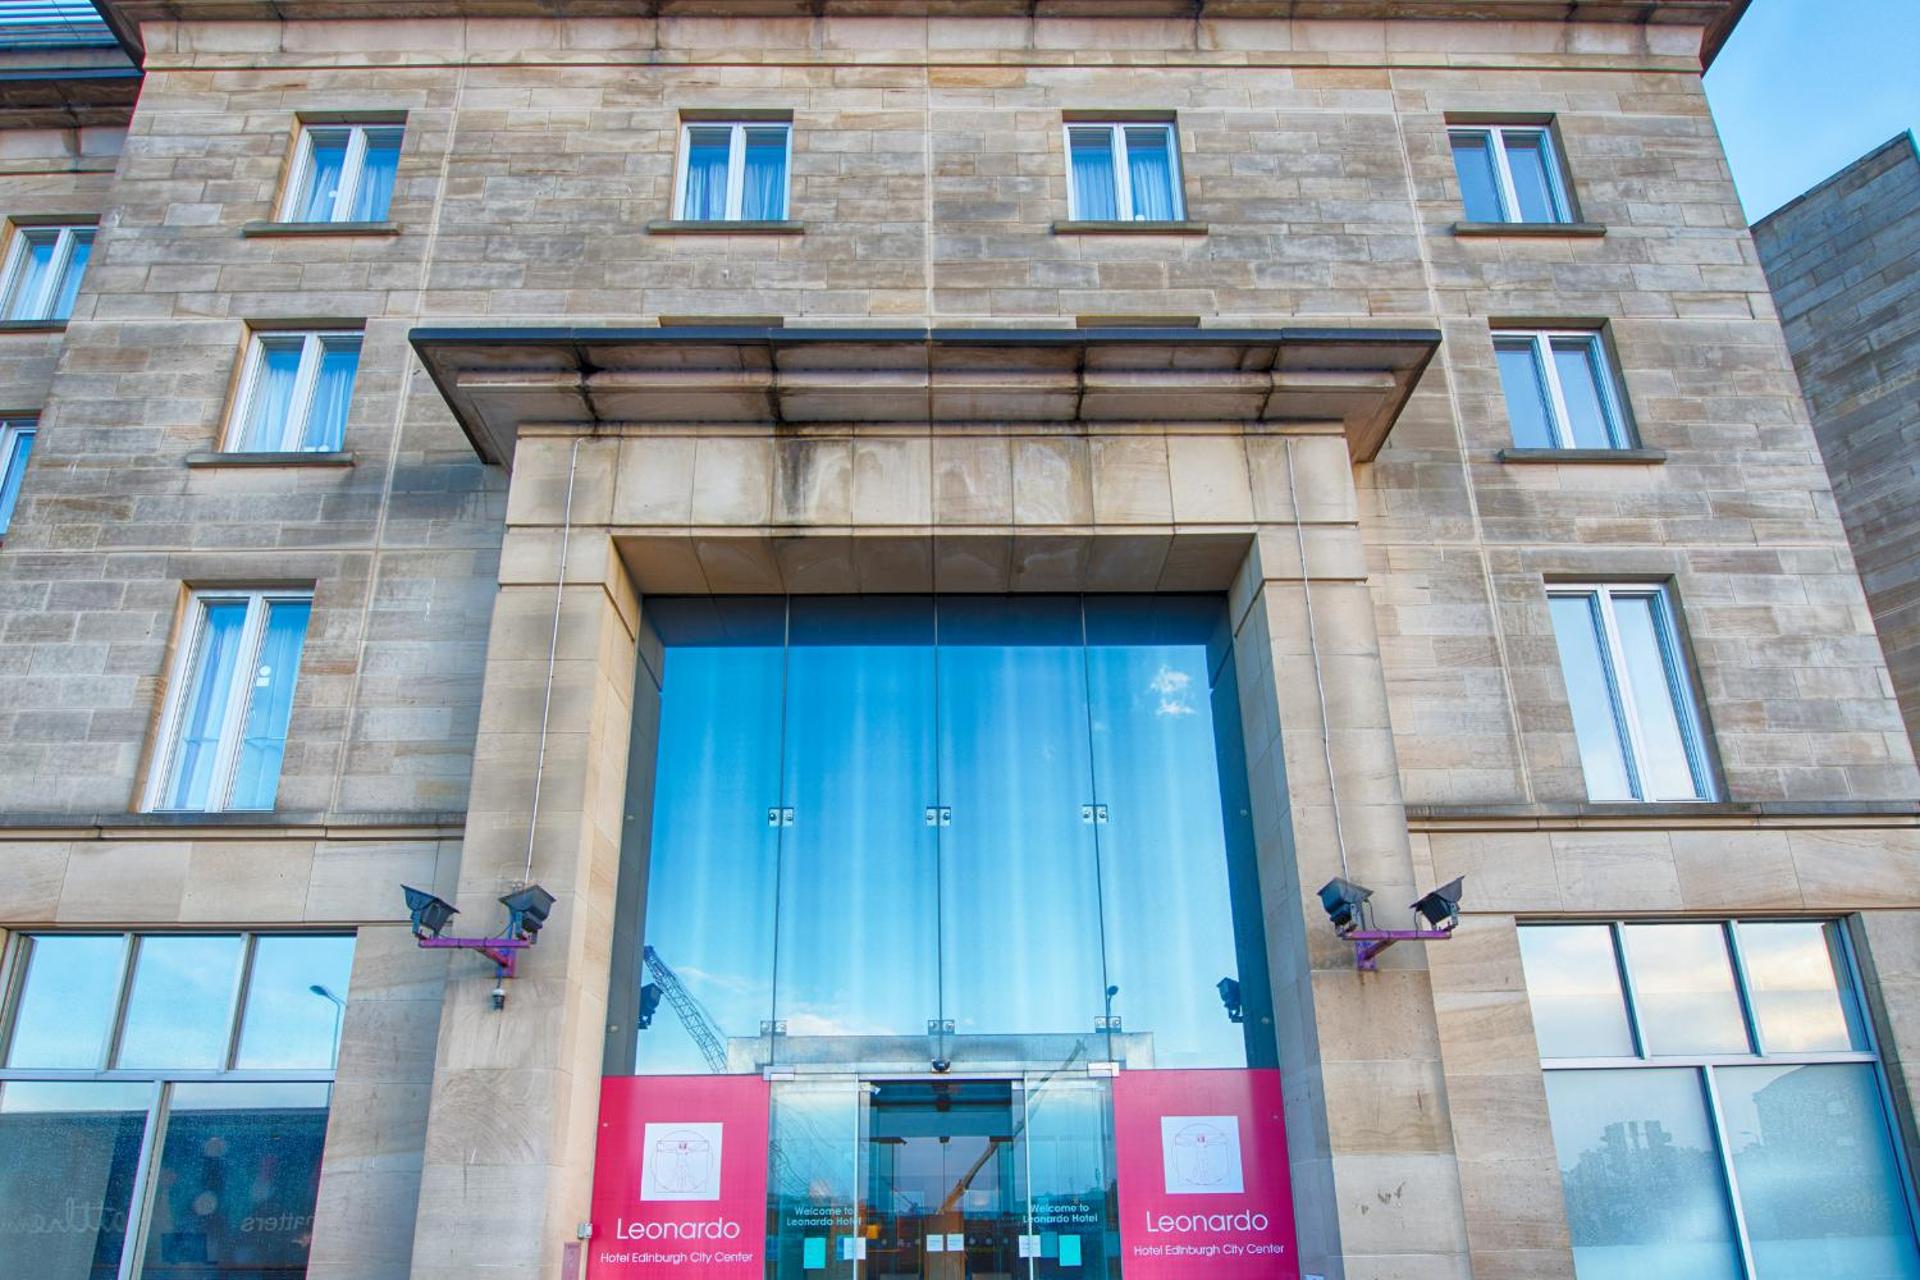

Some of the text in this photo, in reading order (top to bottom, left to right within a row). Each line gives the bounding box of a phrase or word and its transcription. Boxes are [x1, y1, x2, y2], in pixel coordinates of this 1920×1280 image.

[794, 1205, 854, 1216] Welcome to
[1032, 1203, 1090, 1213] Welcome to
[787, 1216, 862, 1226] Leonardo Hotl
[1072, 1213, 1098, 1223] Hotel
[1146, 1210, 1269, 1232] Leonardo
[616, 1217, 740, 1240] Leonardo
[1134, 1243, 1284, 1257] Hotel Edinburgh City Center
[601, 1252, 753, 1265] Hotel Edinburgh City Center
